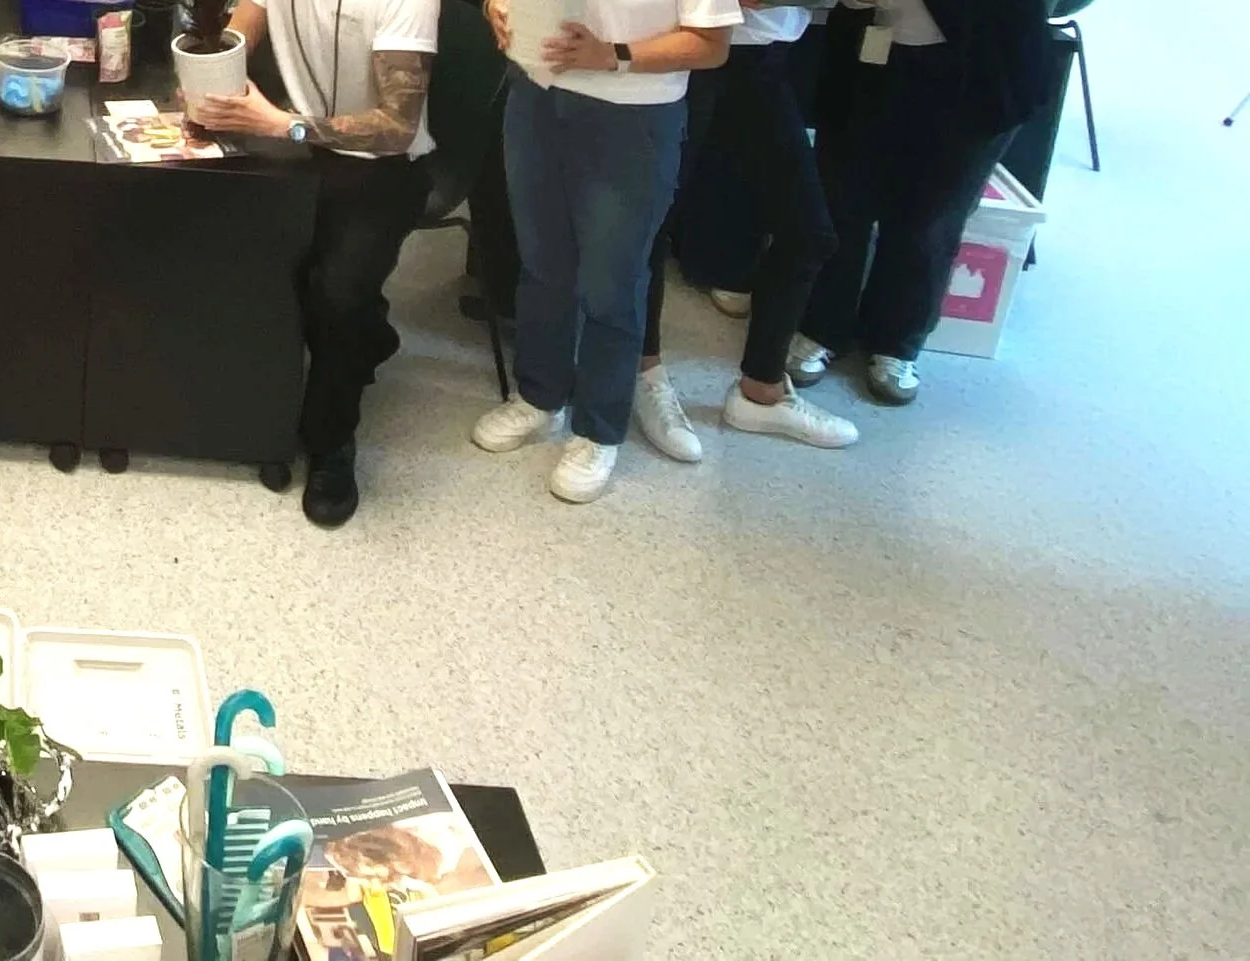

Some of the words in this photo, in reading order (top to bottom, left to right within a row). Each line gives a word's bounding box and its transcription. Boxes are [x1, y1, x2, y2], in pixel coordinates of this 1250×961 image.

[174, 702, 188, 740] Metals
[336, 814, 351, 825] by
[350, 808, 393, 821] happens
